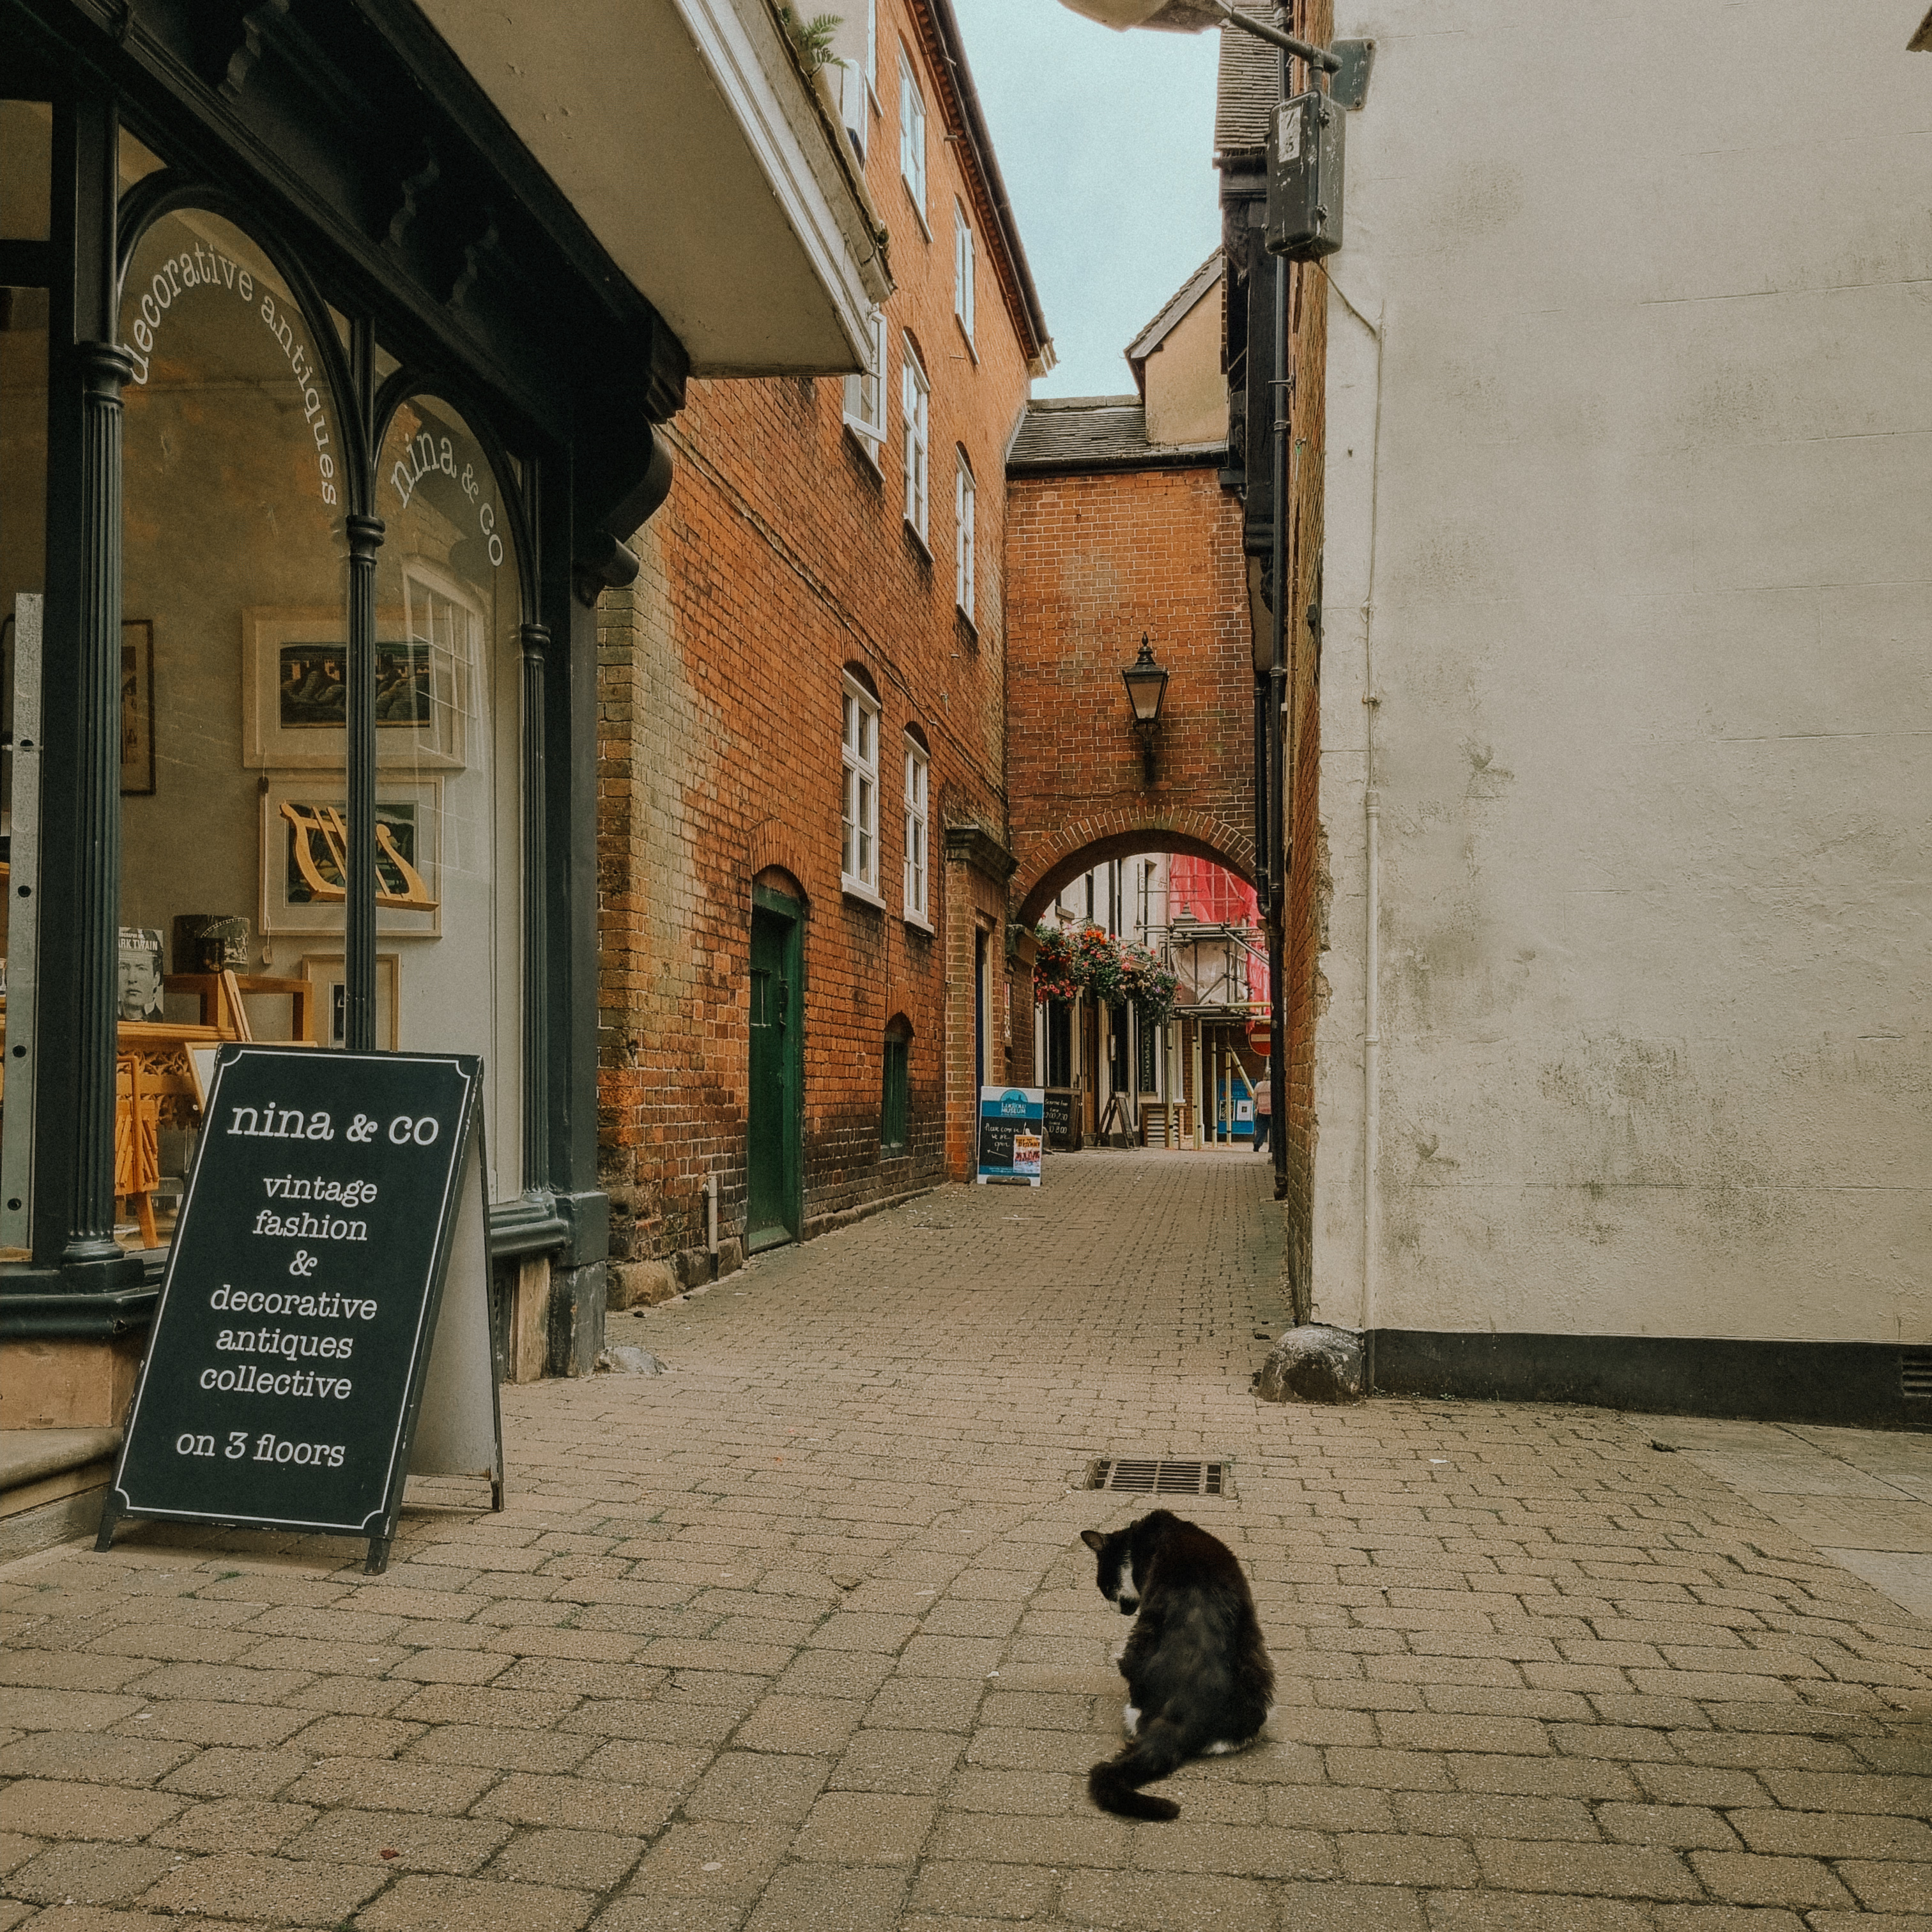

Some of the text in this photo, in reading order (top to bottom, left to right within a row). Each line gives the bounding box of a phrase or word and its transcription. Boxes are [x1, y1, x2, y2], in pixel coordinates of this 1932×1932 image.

[124, 242, 337, 506] decorative antiques
[390, 432, 503, 567] nina & co
[133, 939, 158, 951] TWAIN
[227, 1101, 440, 1146] nina & co
[263, 1174, 378, 1208] vintage
[252, 1209, 368, 1241] fashion
[289, 1250, 318, 1276] &
[210, 1284, 378, 1321] decorative
[216, 1327, 353, 1361] antiques
[200, 1365, 352, 1399] collective
[176, 1431, 346, 1467] on 3 floors
